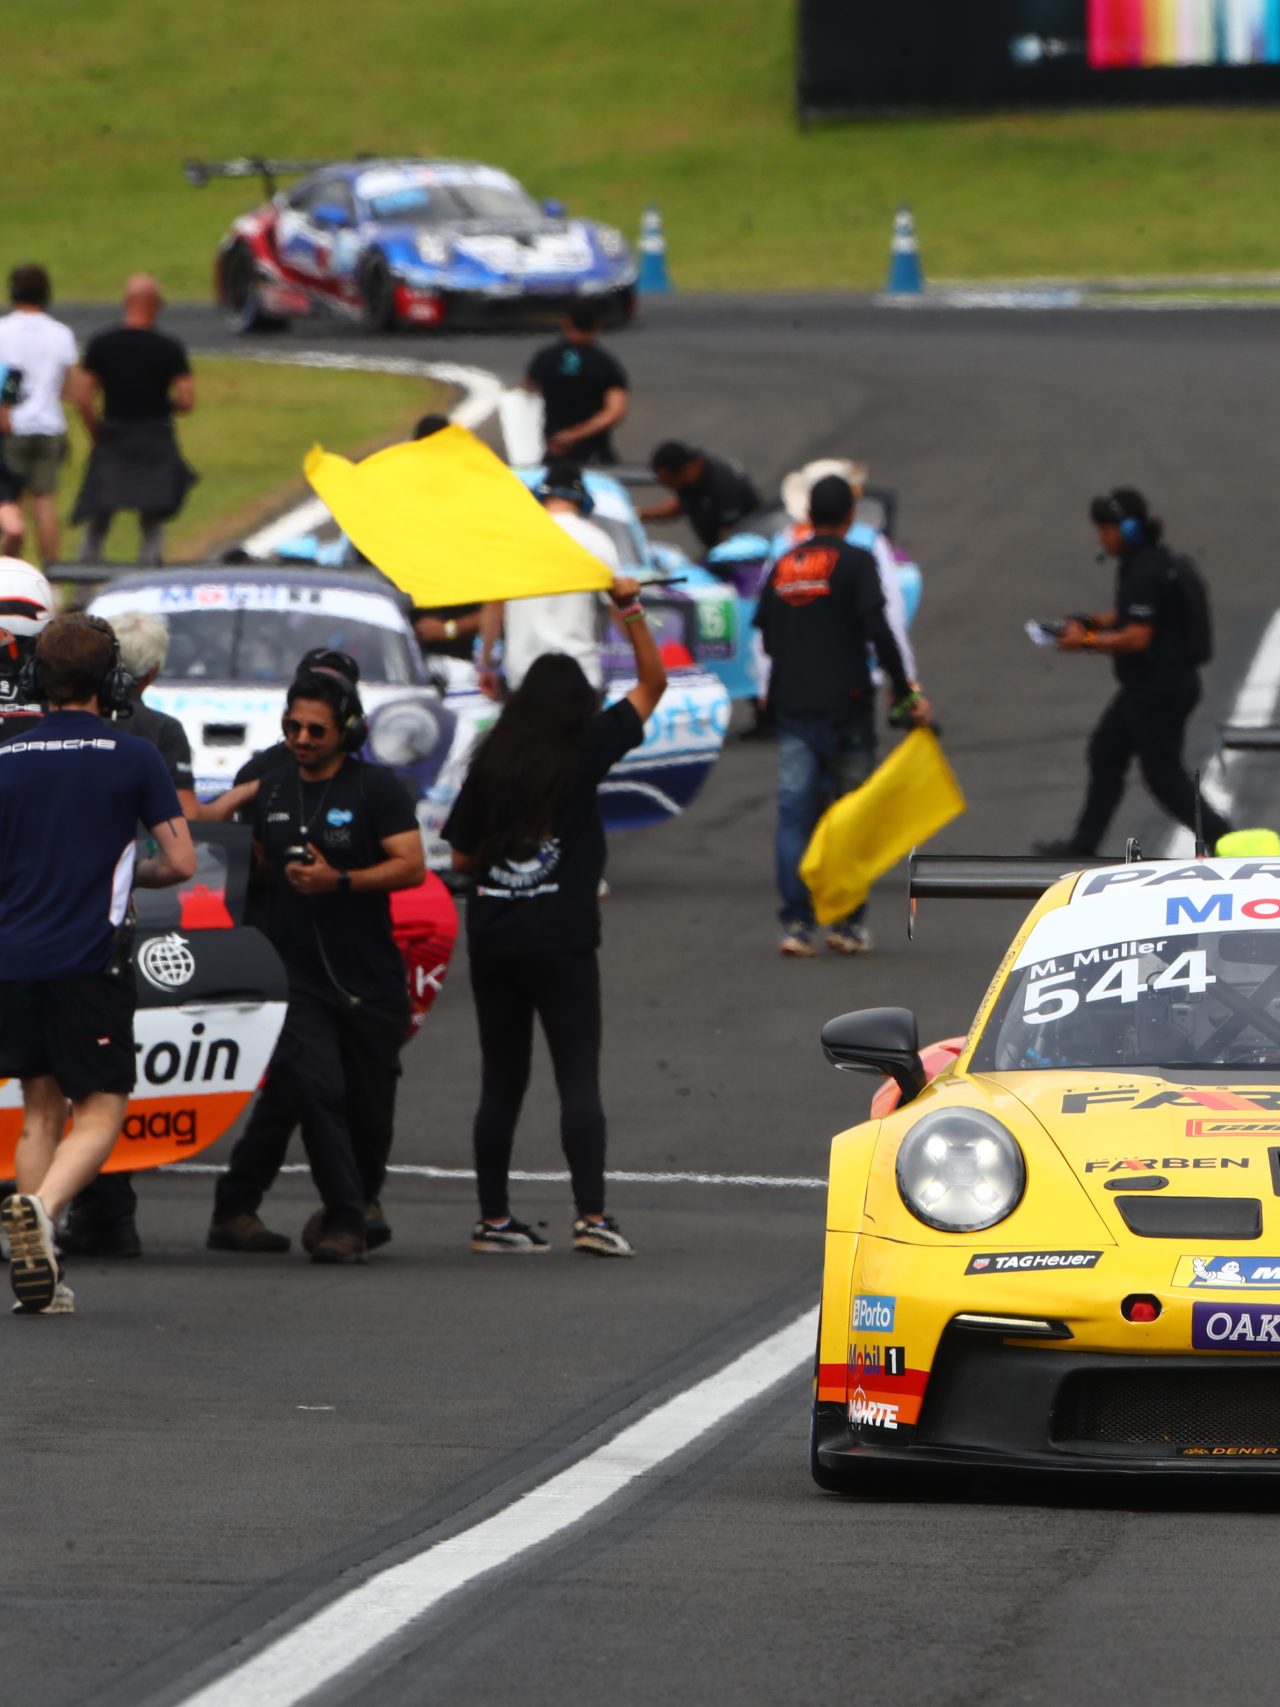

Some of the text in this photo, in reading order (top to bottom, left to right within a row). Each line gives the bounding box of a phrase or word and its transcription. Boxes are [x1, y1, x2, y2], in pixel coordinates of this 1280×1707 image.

[1030, 938, 1168, 980] M. Muller
[1022, 949, 1217, 1025] 544
[136, 1022, 240, 1085] oin
[1085, 1157, 1250, 1173] FARBEN
[859, 1300, 891, 1328] Porto
